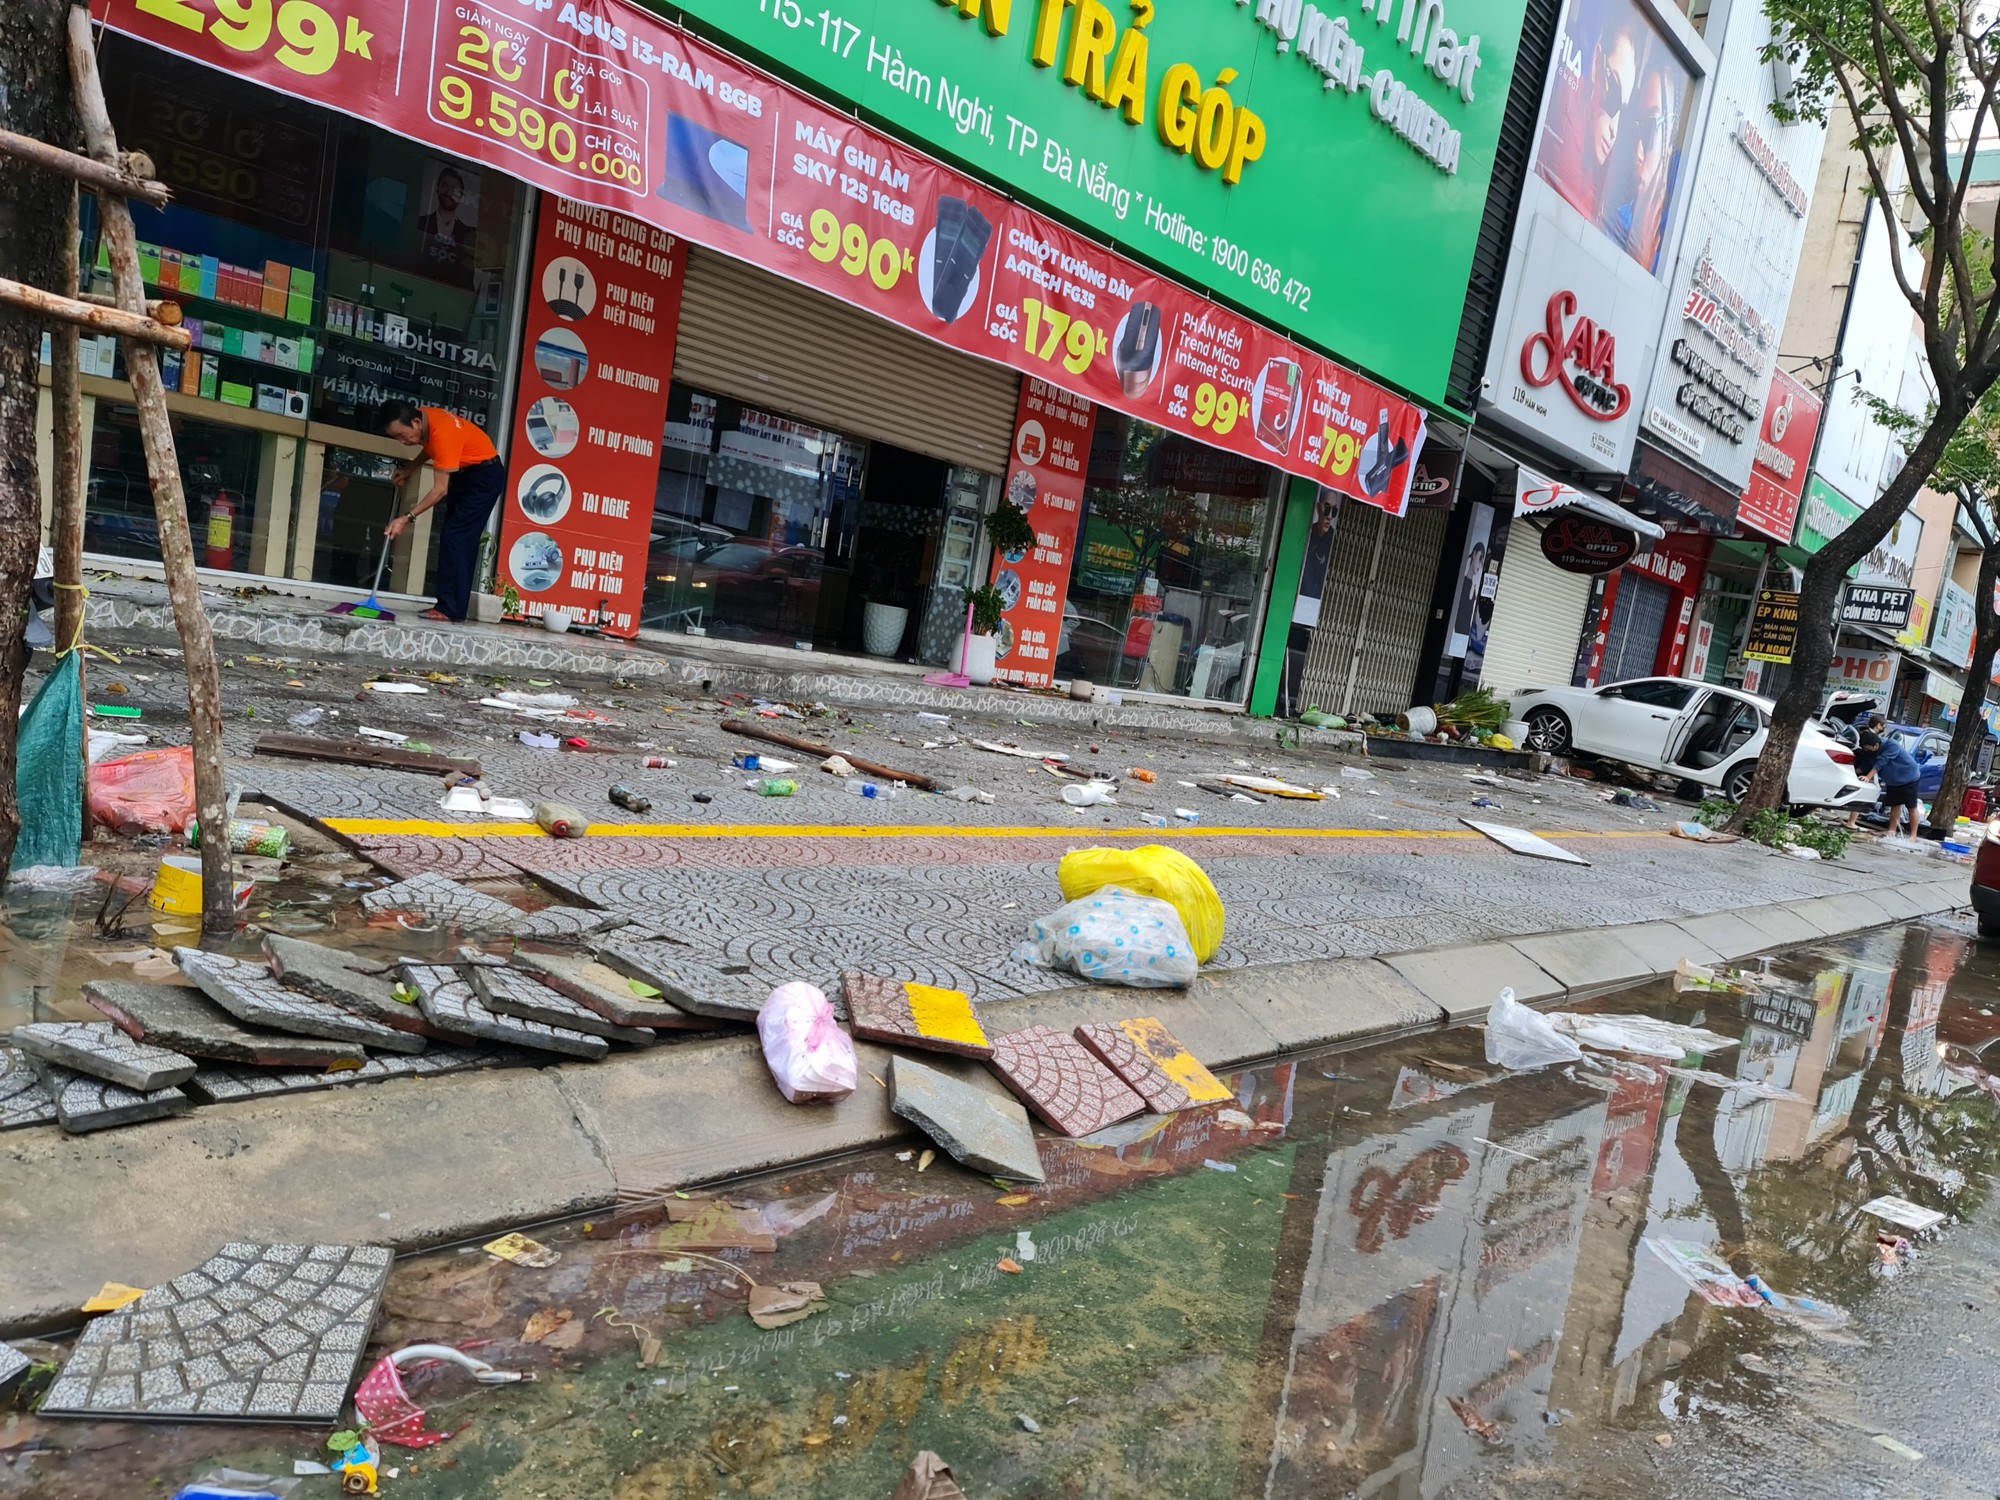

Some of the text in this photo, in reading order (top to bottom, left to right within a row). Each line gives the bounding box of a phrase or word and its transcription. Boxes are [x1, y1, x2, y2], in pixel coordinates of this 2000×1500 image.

[455, 6, 491, 29] GIẢM
[494, 22, 530, 46] NGAY
[556, 3, 763, 118] ASUS i3-RAM 8GB
[571, 59, 623, 87] TRẢ GÓP
[1032, 0, 1267, 186] TRẢ GÓP
[584, 100, 639, 132] LÃI SUẤT
[584, 135, 641, 165] CHỈ CÒN
[795, 120, 911, 193] MÁY GHI ÂM
[866, 36, 932, 105] Hàm
[936, 77, 996, 146] Nghi,
[1005, 114, 1039, 157] TP
[1042, 139, 1073, 183] Đà
[1077, 160, 1131, 220] Nẵng
[1144, 197, 1209, 256] Hotline:
[1210, 236, 1250, 278] 1900
[1250, 257, 1283, 296] 636
[1282, 277, 1312, 313] 472
[793, 153, 916, 226] SKY 125 16GB
[612, 215, 647, 246] CUNG
[780, 211, 804, 231] GIÁ
[555, 219, 673, 281] PHỤ KIỆN CÁC LOẠI
[776, 228, 805, 250] SỐC
[1008, 228, 1135, 302] CHUỘT KHÔNG DÂY
[1004, 253, 1096, 310] A4TECH FG35
[605, 282, 655, 315] PHỤ KIỆN
[603, 305, 656, 336] ĐIỆN THOẠI
[995, 303, 1018, 324] GIÁ
[989, 320, 1018, 344] SỐC
[1182, 312, 1244, 353] PHẦN MỀM
[1174, 348, 1219, 380] Internet
[1179, 330, 1241, 370] Trend Micro
[597, 362, 660, 394] LOA BLUETOOTH
[1173, 383, 1189, 404] GIÁ
[1316, 379, 1352, 408] THIẾT BỊ
[1512, 386, 1526, 403] 119
[1167, 399, 1187, 419] SỐC
[1350, 417, 1368, 436] USB
[588, 426, 653, 457] PIN DỰ PHÒNG
[582, 492, 631, 520] TAI NGHE
[1051, 494, 1064, 508] SINH
[1063, 498, 1077, 513] MÁY
[574, 547, 624, 575] PHỤ KIỆN
[1561, 555, 1576, 563] 119
[1586, 543, 1619, 553] OPTIC
[1652, 550, 1687, 583] TRẢ GÓP
[571, 568, 623, 595] MÁY TÍNH
[1683, 598, 1694, 612] 123
[1852, 588, 1908, 606] KHA PET
[617, 612, 632, 631] VỤ
[1757, 604, 1798, 621] ÉP KÍNH
[1843, 604, 1860, 620] CÚN
[1861, 605, 1881, 622] MÈO
[1881, 606, 1906, 625] CẢNH
[1764, 622, 1796, 633] MÀN HÌNH
[1766, 643, 1791, 655] NGAY
[1829, 653, 1894, 682] PHỞ
